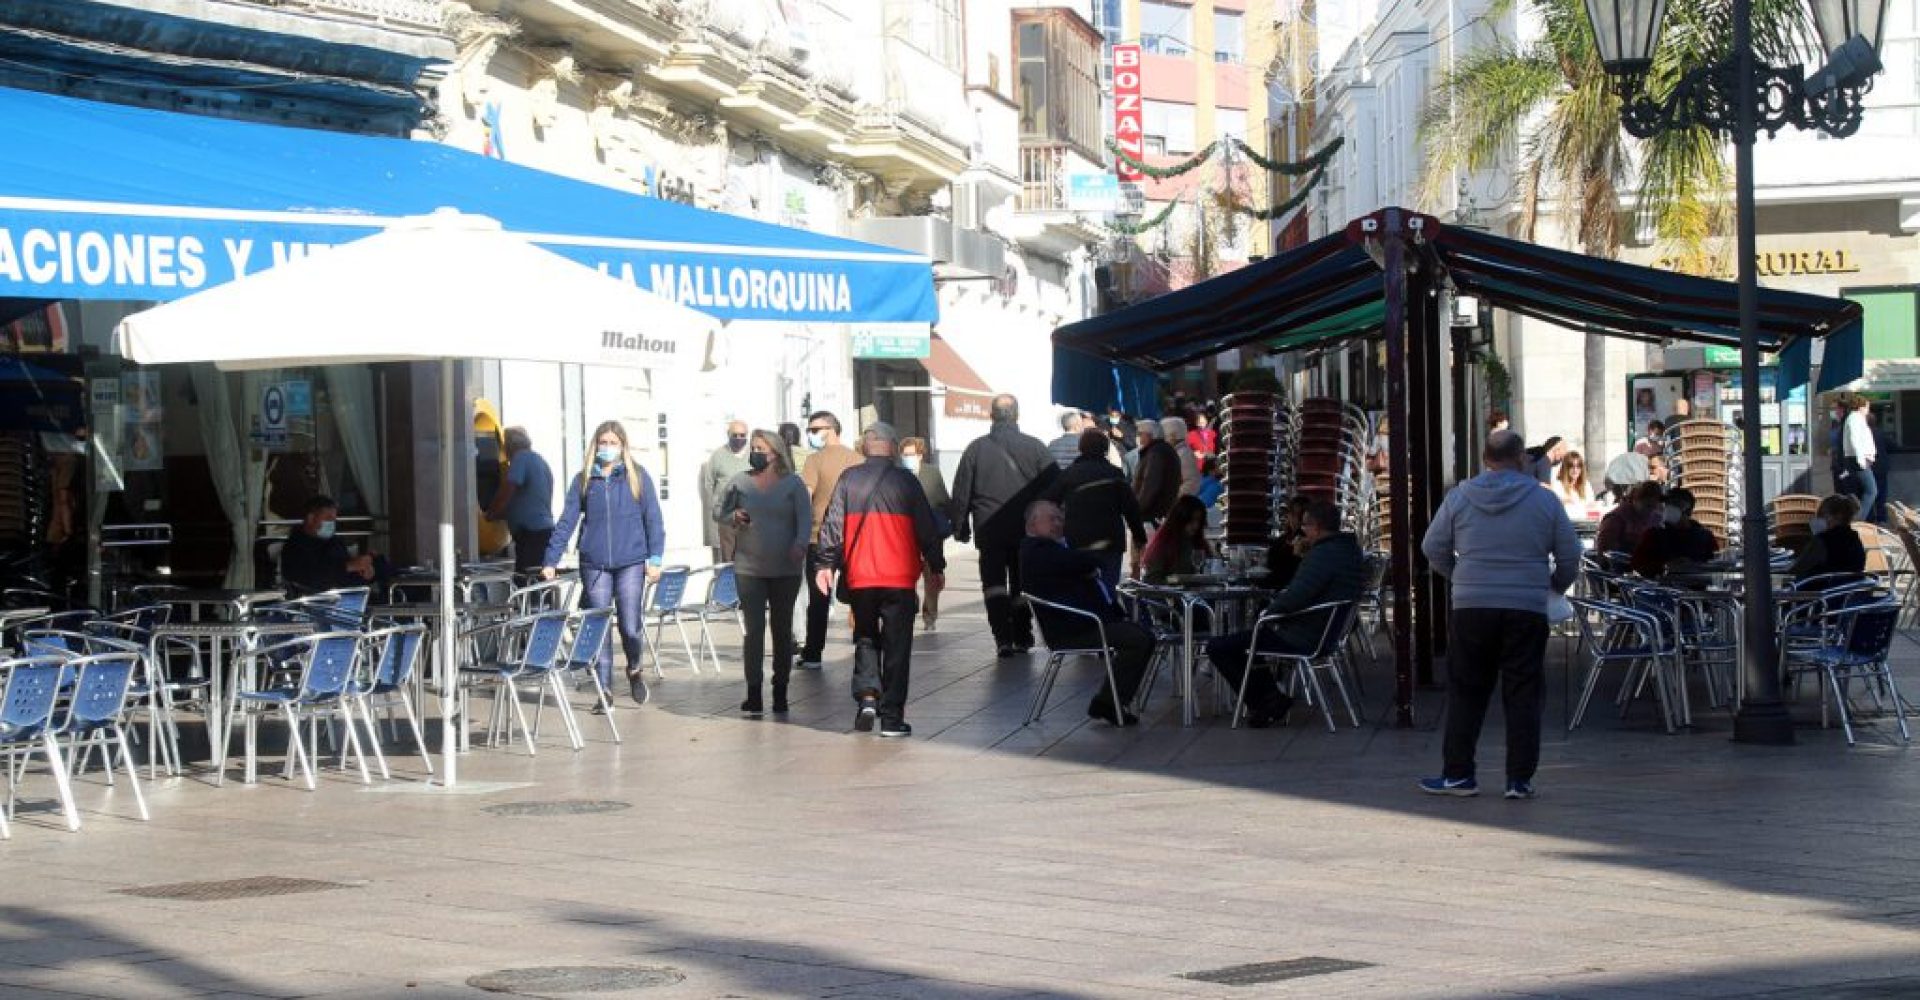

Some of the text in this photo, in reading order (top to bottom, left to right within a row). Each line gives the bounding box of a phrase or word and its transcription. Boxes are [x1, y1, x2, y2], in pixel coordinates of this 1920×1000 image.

[222, 239, 254, 281] Y
[650, 263, 852, 312] MALLORQUINA
[601, 330, 676, 354] Mahou
